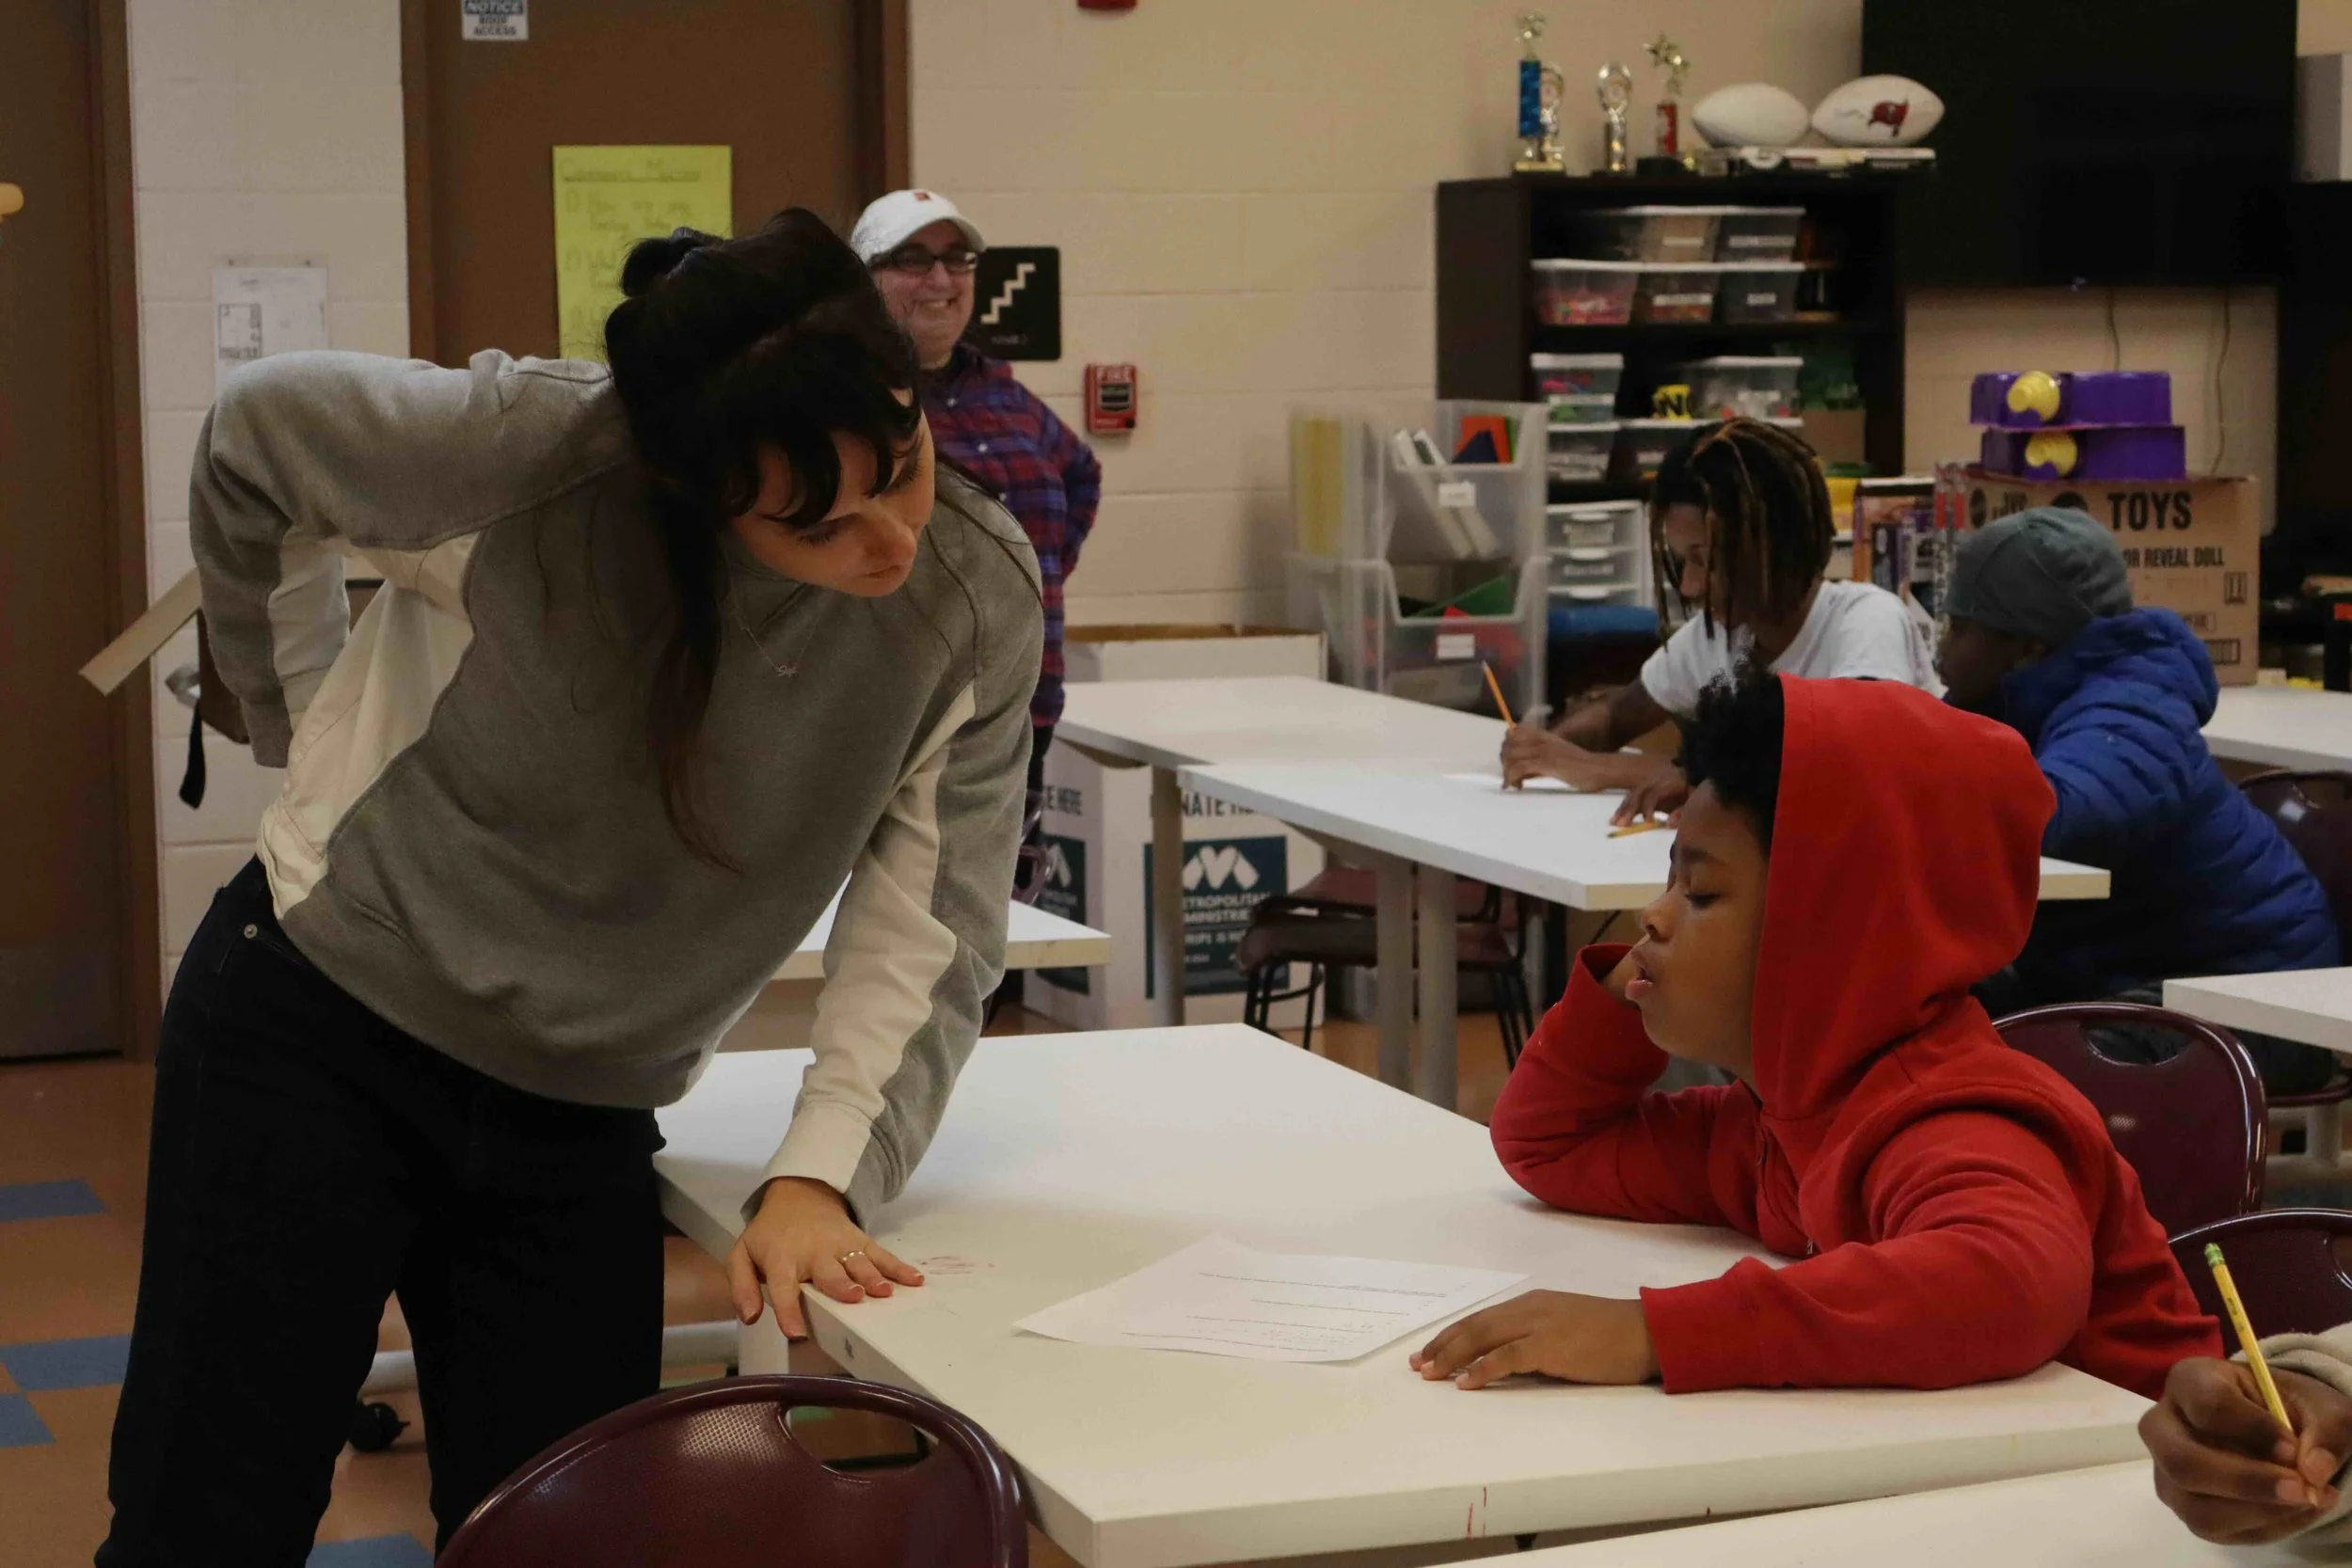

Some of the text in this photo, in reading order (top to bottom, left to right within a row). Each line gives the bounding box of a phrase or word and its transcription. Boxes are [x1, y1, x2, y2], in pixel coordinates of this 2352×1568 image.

[466, 0, 523, 13] NOTICE
[473, 25, 516, 35] ACCESS
[1096, 366, 1133, 383] FIRE
[2106, 491, 2192, 531] TOYS
[2145, 547, 2188, 567] REVEAL
[2194, 546, 2224, 567] DOLL
